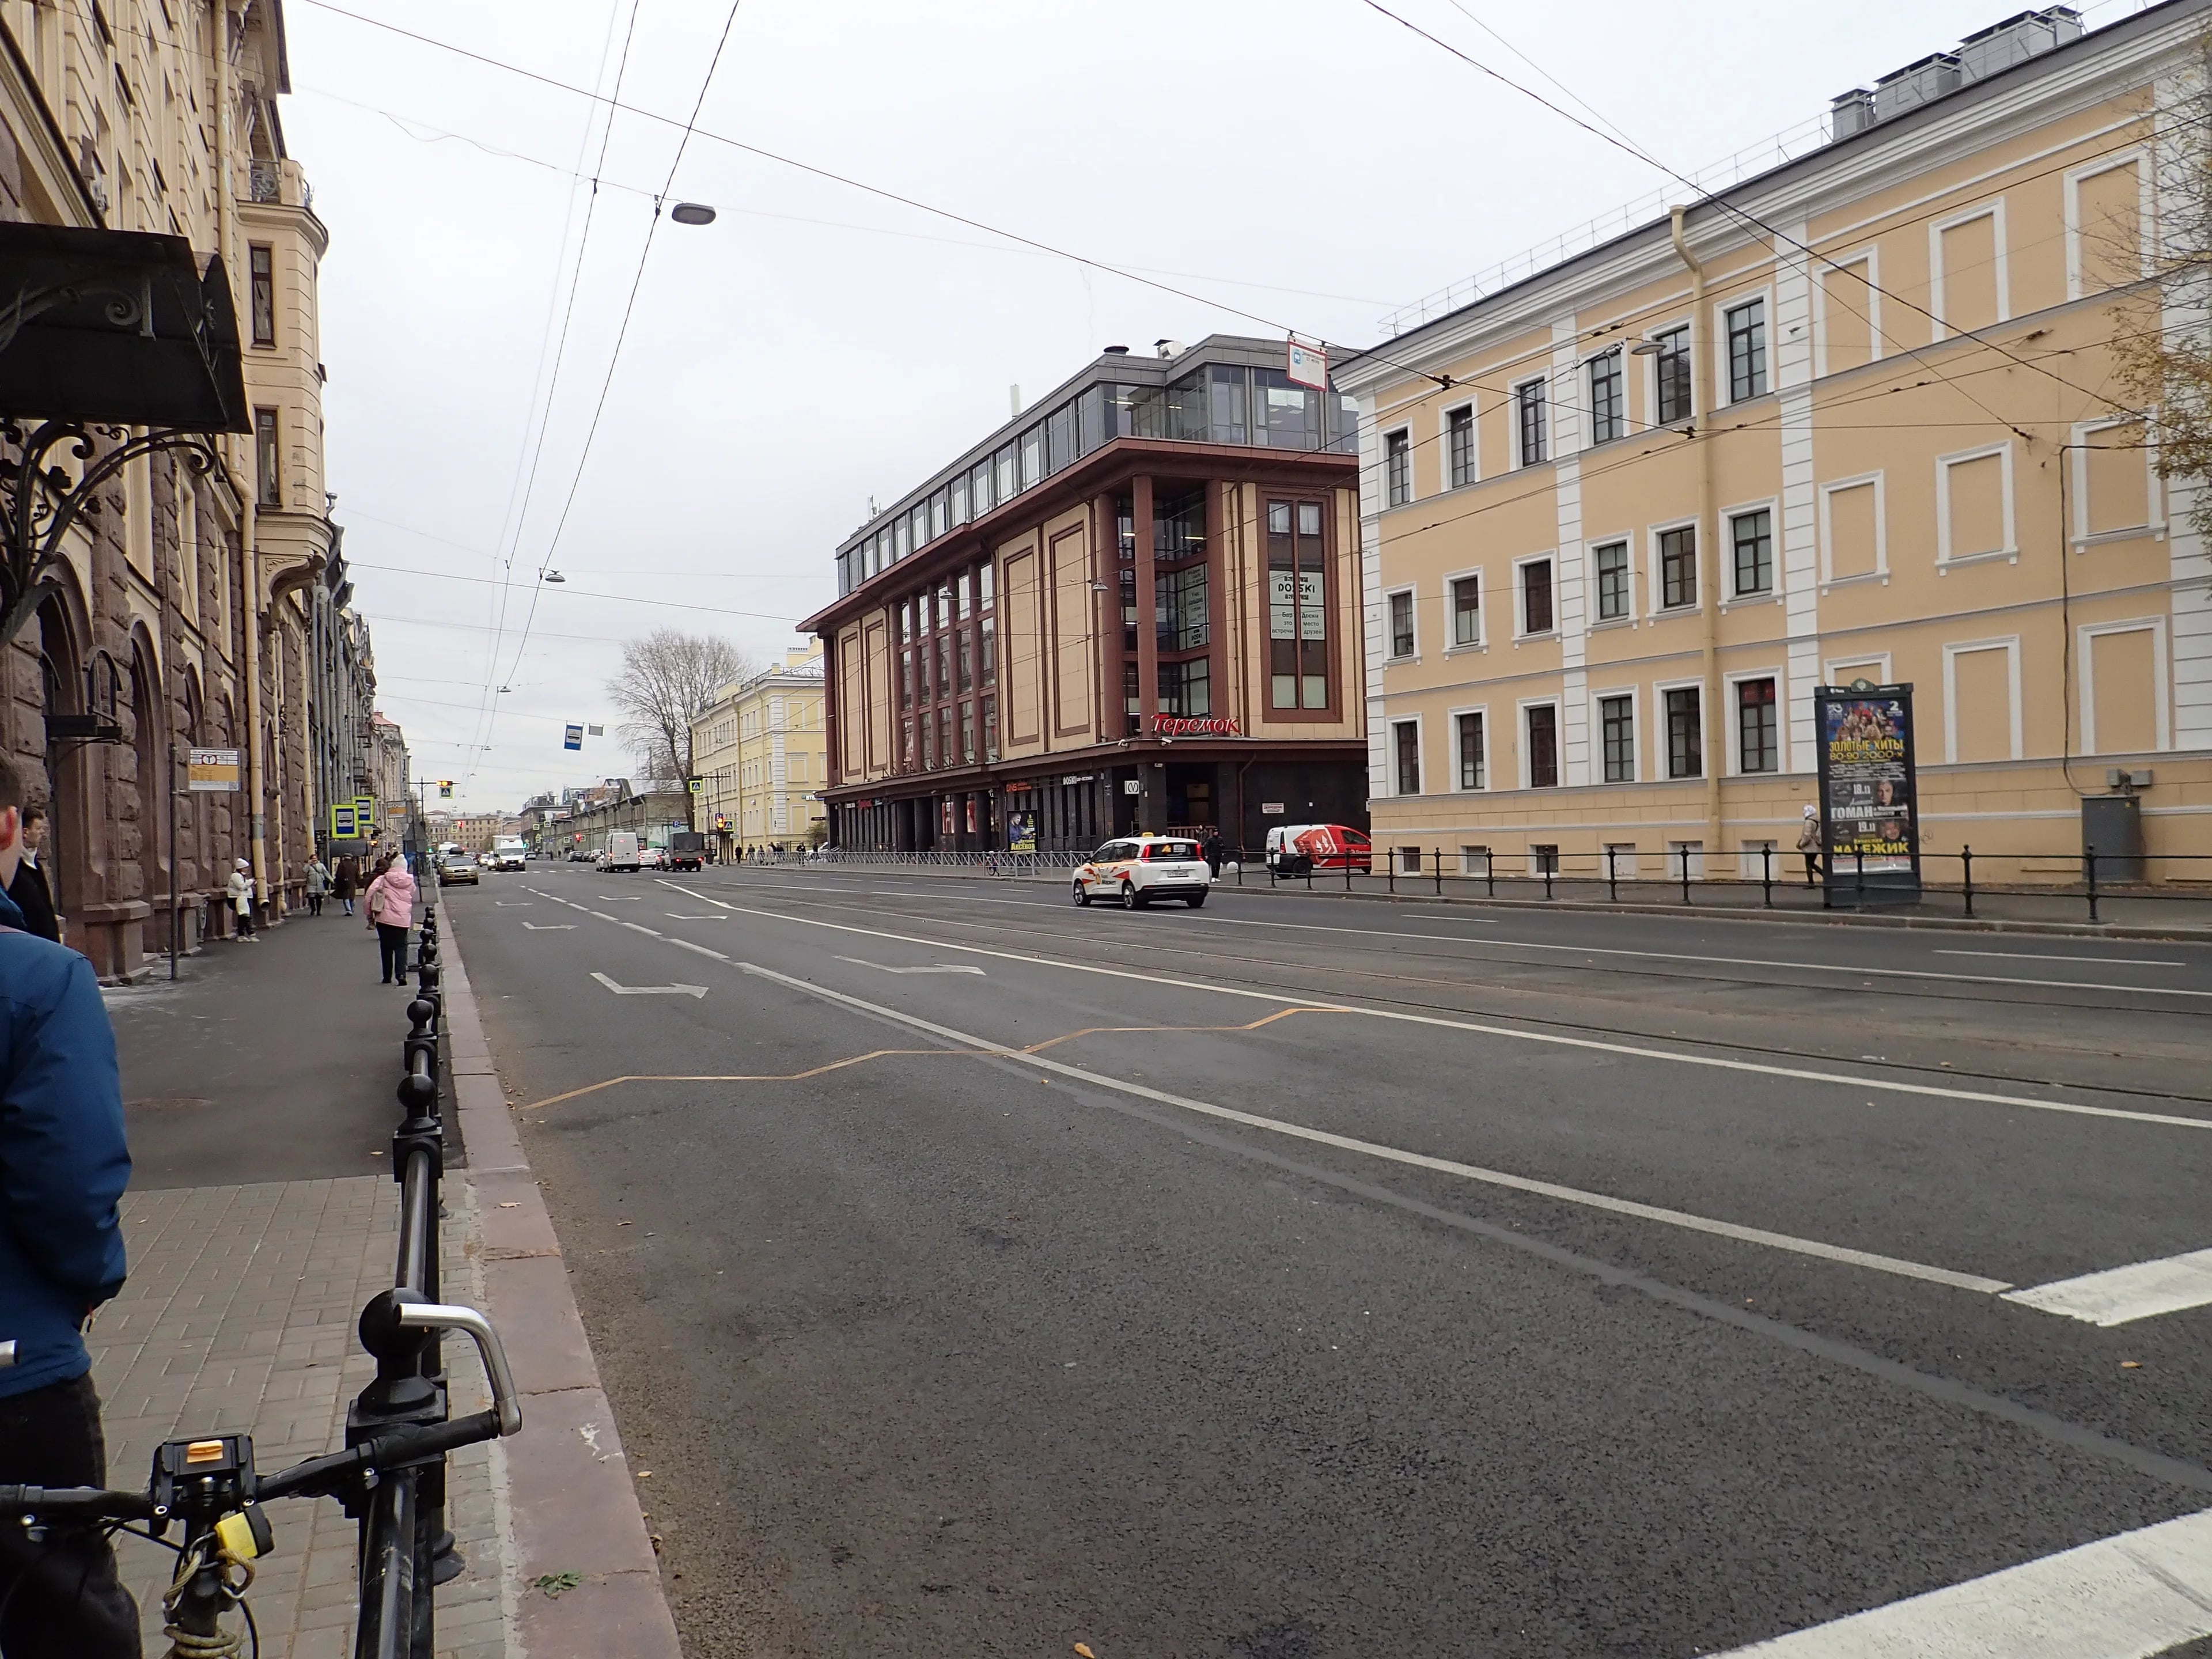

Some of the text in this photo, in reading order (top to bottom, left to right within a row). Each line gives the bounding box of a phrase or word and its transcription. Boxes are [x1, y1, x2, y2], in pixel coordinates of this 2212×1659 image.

[1889, 701, 1899, 711] 2
[1151, 714, 1241, 737] Теремок
[1829, 739, 1904, 752] ЗОЛОТЫЕ ХИТЫ
[1854, 784, 1870, 794] 18.11
[1831, 806, 1873, 819] ГОМАН
[1858, 821, 1876, 832] 19.11
